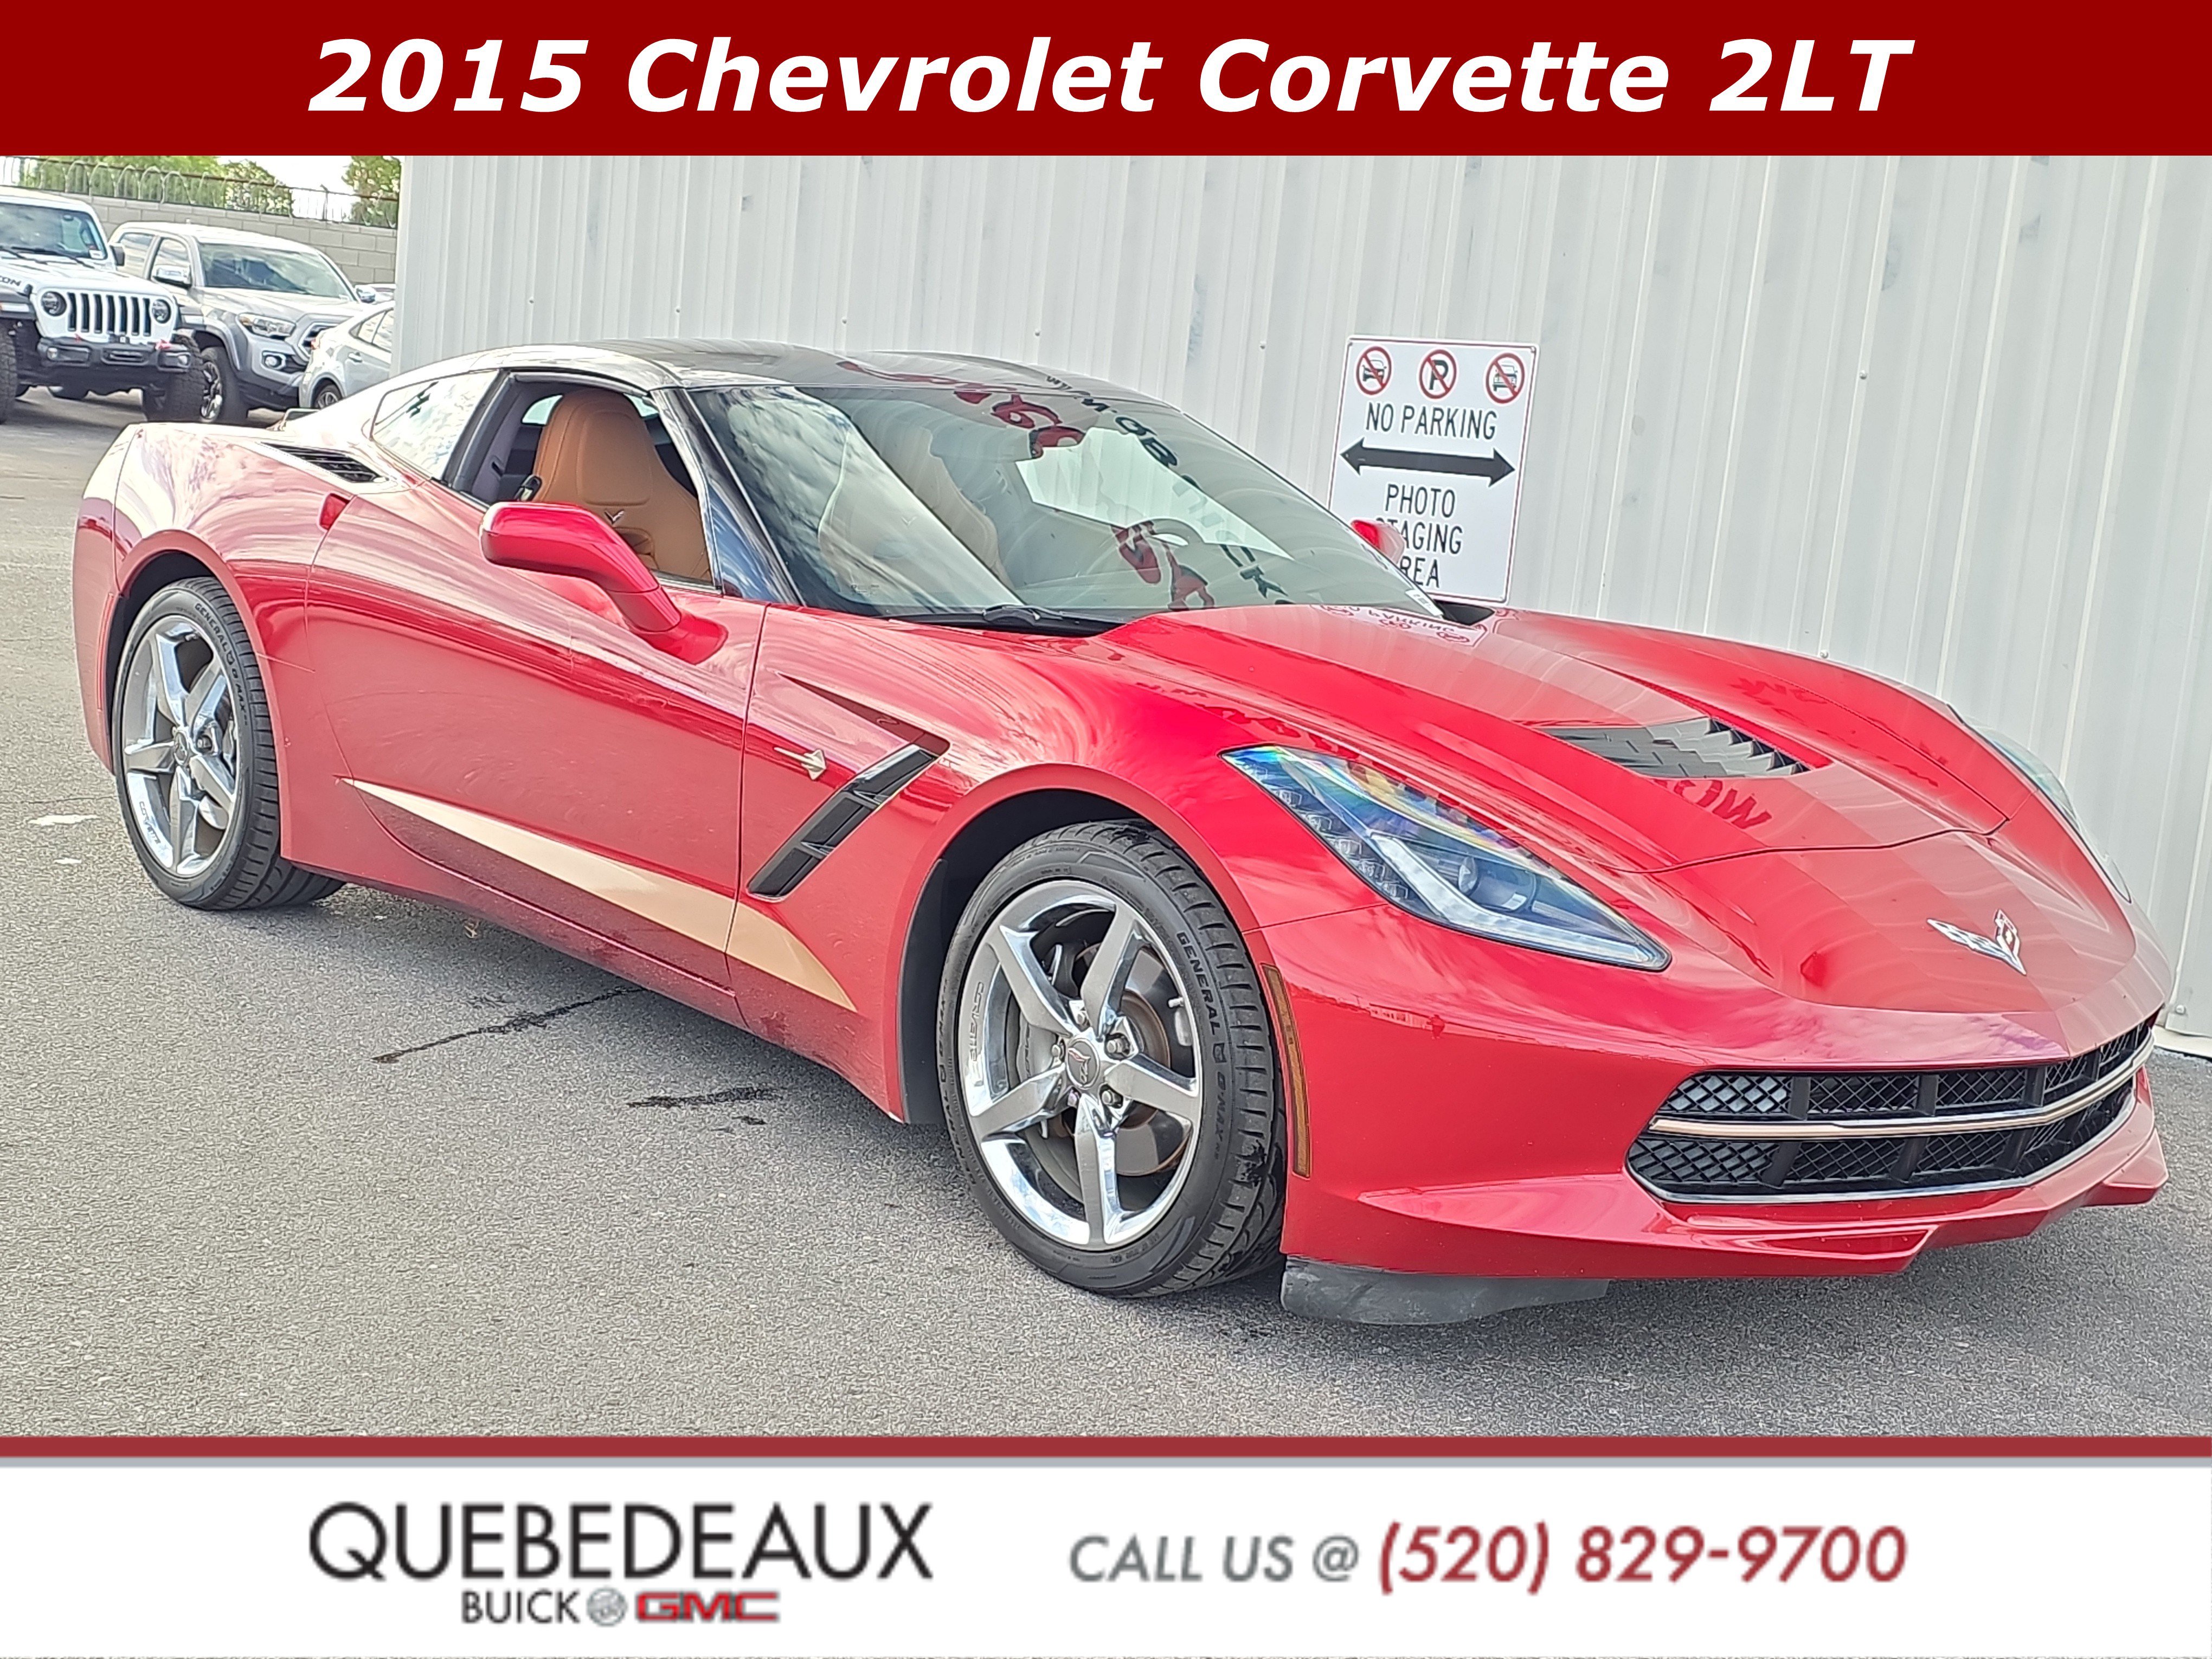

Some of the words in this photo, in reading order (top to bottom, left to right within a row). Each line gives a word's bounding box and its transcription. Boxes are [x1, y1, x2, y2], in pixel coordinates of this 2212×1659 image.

[1366, 402, 1394, 432] NO
[1400, 404, 1498, 440] PARKING
[1384, 483, 1456, 518] PHOTO
[1375, 517, 1463, 555] AGING
[1400, 556, 1439, 588] REA
[194, 602, 229, 653] GENERAL
[1176, 931, 1220, 1036] GENERAL
